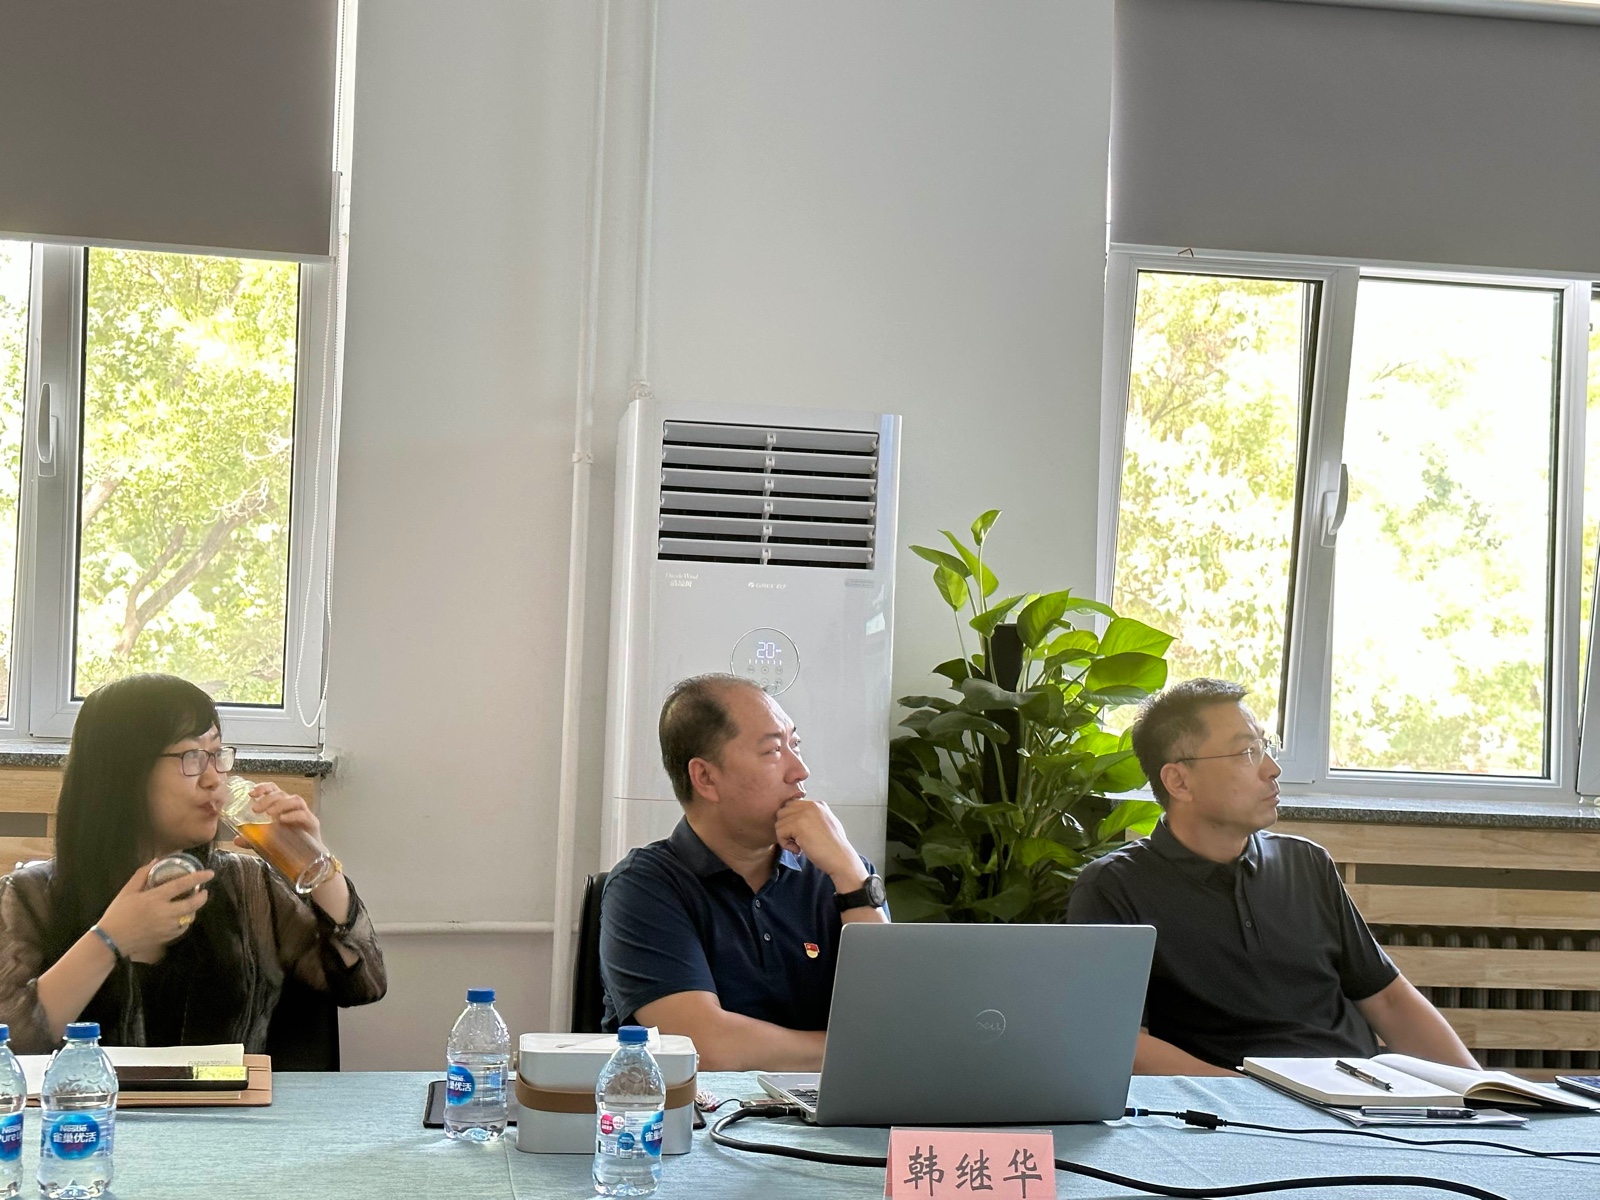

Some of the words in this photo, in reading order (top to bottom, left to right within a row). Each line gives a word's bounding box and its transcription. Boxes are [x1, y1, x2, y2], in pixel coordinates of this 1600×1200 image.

[52, 1131, 97, 1144] 雀巢优活
[903, 1144, 1043, 1199] 韩继华
